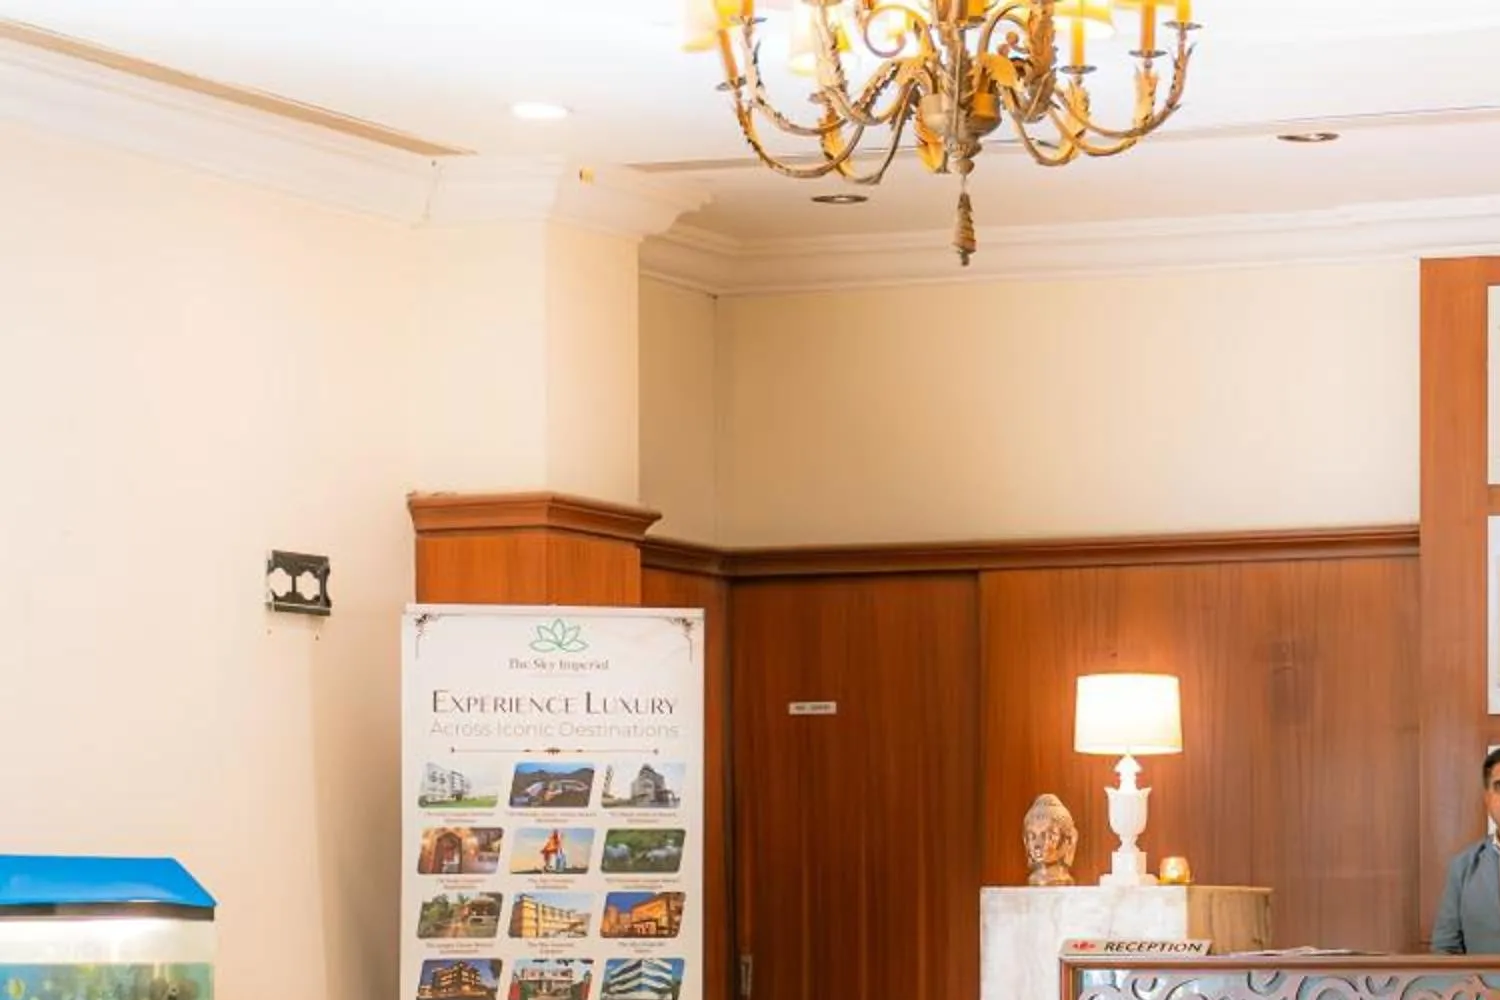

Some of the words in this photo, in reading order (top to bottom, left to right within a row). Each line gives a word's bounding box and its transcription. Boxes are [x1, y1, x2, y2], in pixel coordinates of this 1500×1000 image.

[509, 658, 527, 669] The
[533, 657, 555, 672] Sky
[559, 657, 609, 672] Imperial
[432, 689, 576, 714] EXPERIENCE
[585, 691, 677, 715] LUXURY
[430, 720, 490, 737] Across
[496, 720, 554, 737] Iconic
[558, 720, 680, 738] Destinations
[1103, 940, 1203, 953] RECEPTION
